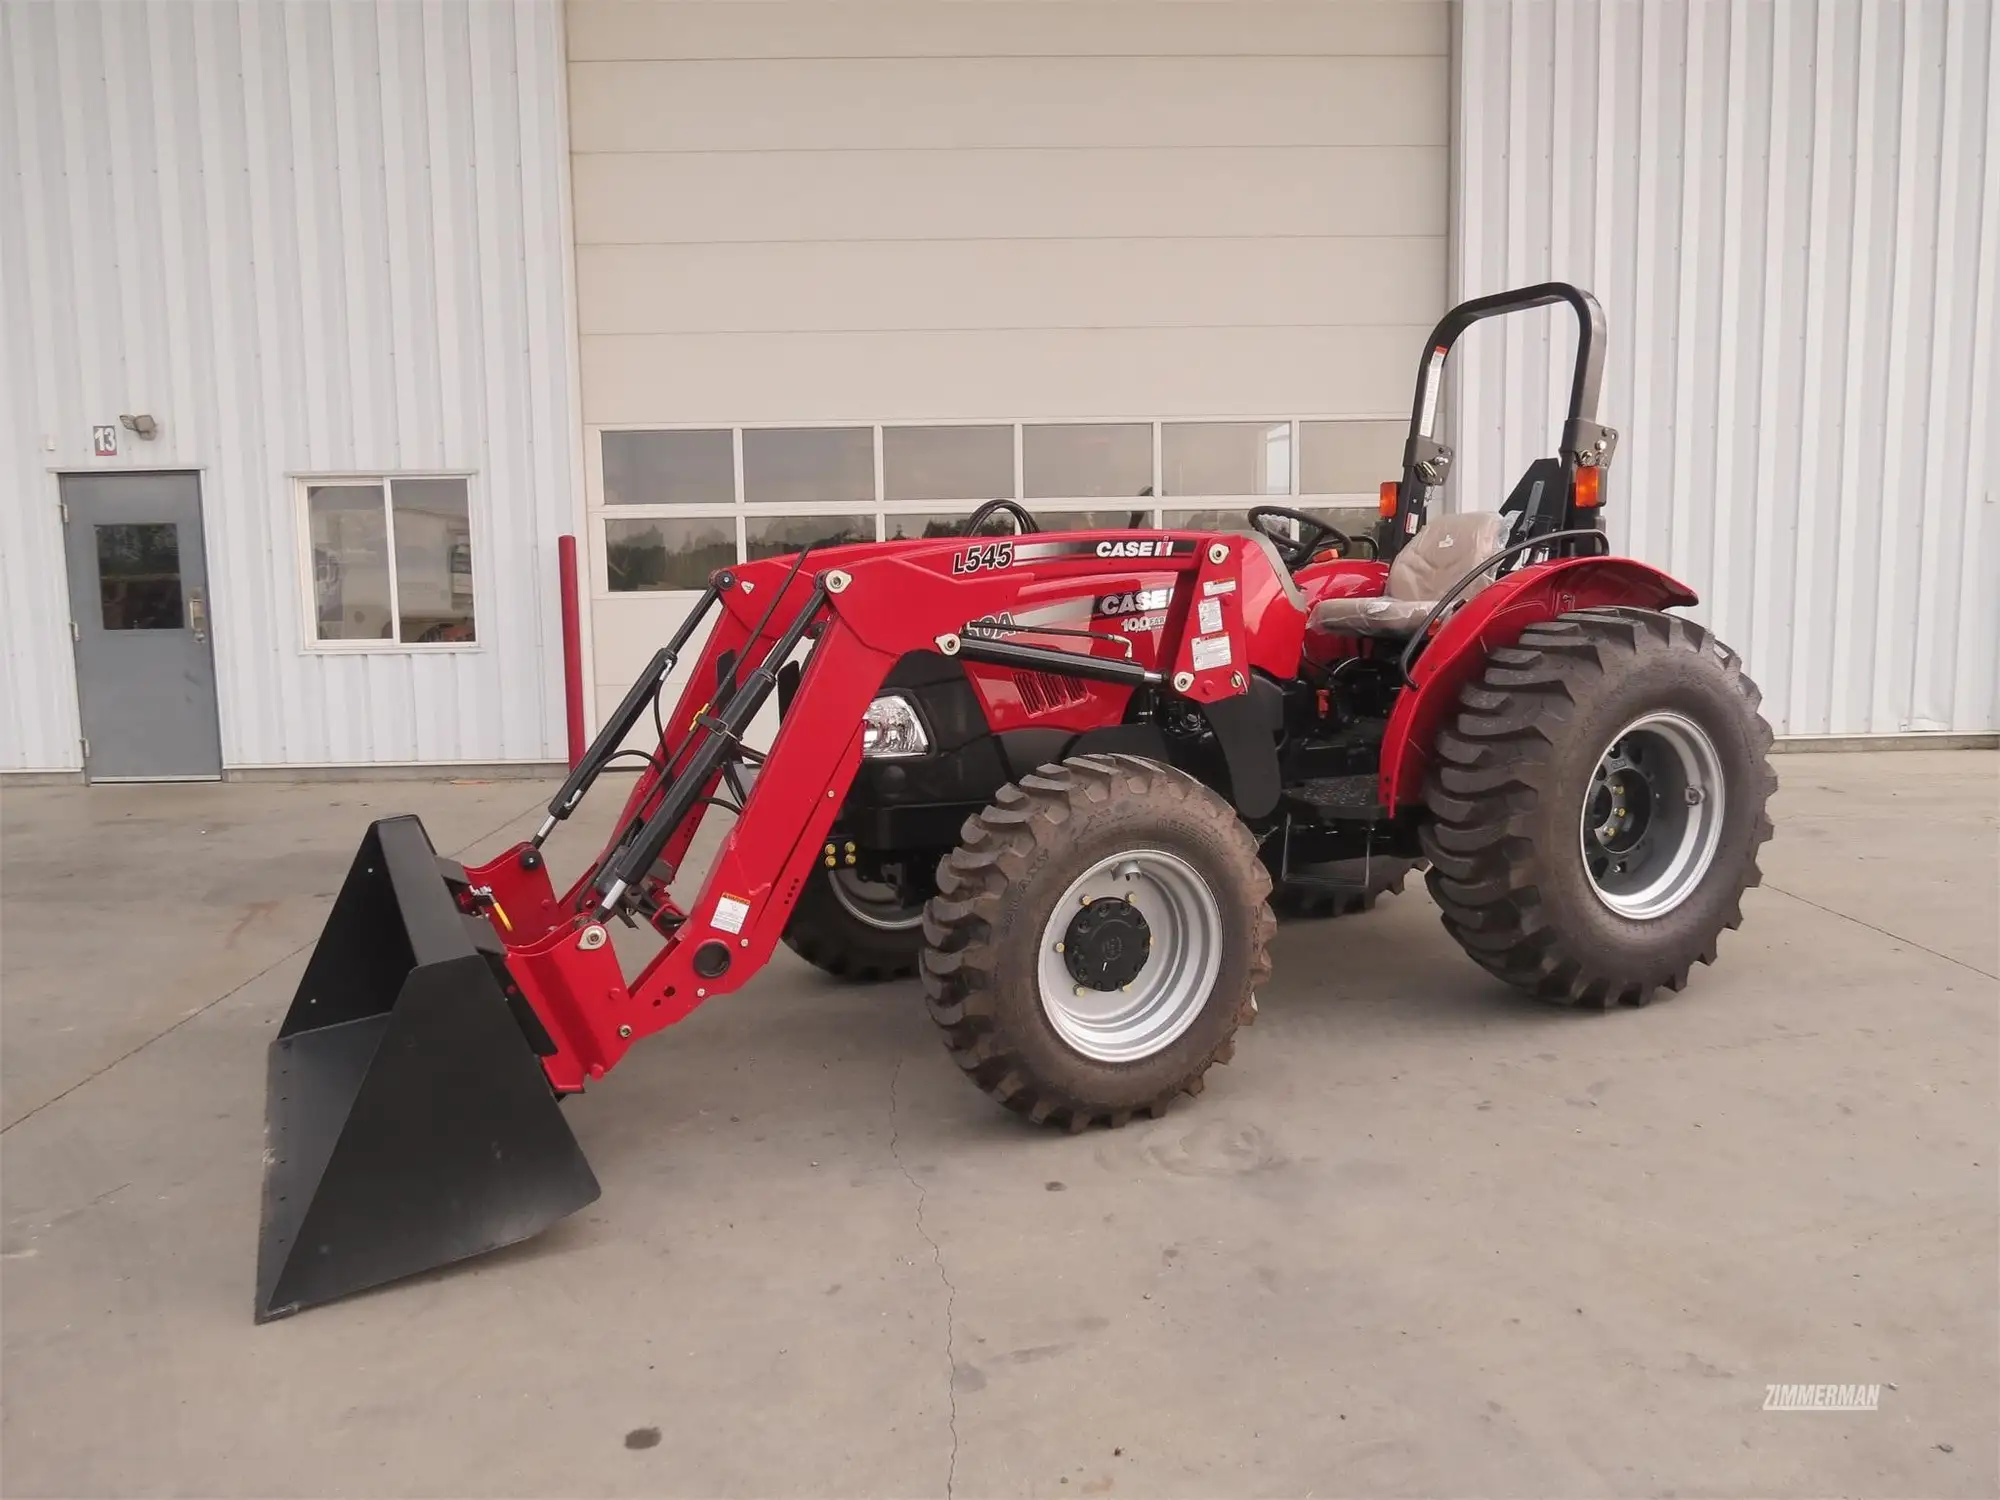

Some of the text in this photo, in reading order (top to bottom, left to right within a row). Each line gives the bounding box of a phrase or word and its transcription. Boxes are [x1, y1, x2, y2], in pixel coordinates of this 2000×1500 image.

[94, 427, 116, 451] 13
[952, 541, 1014, 575] L545
[1096, 541, 1154, 557] CASE
[1101, 589, 1168, 616] CASE
